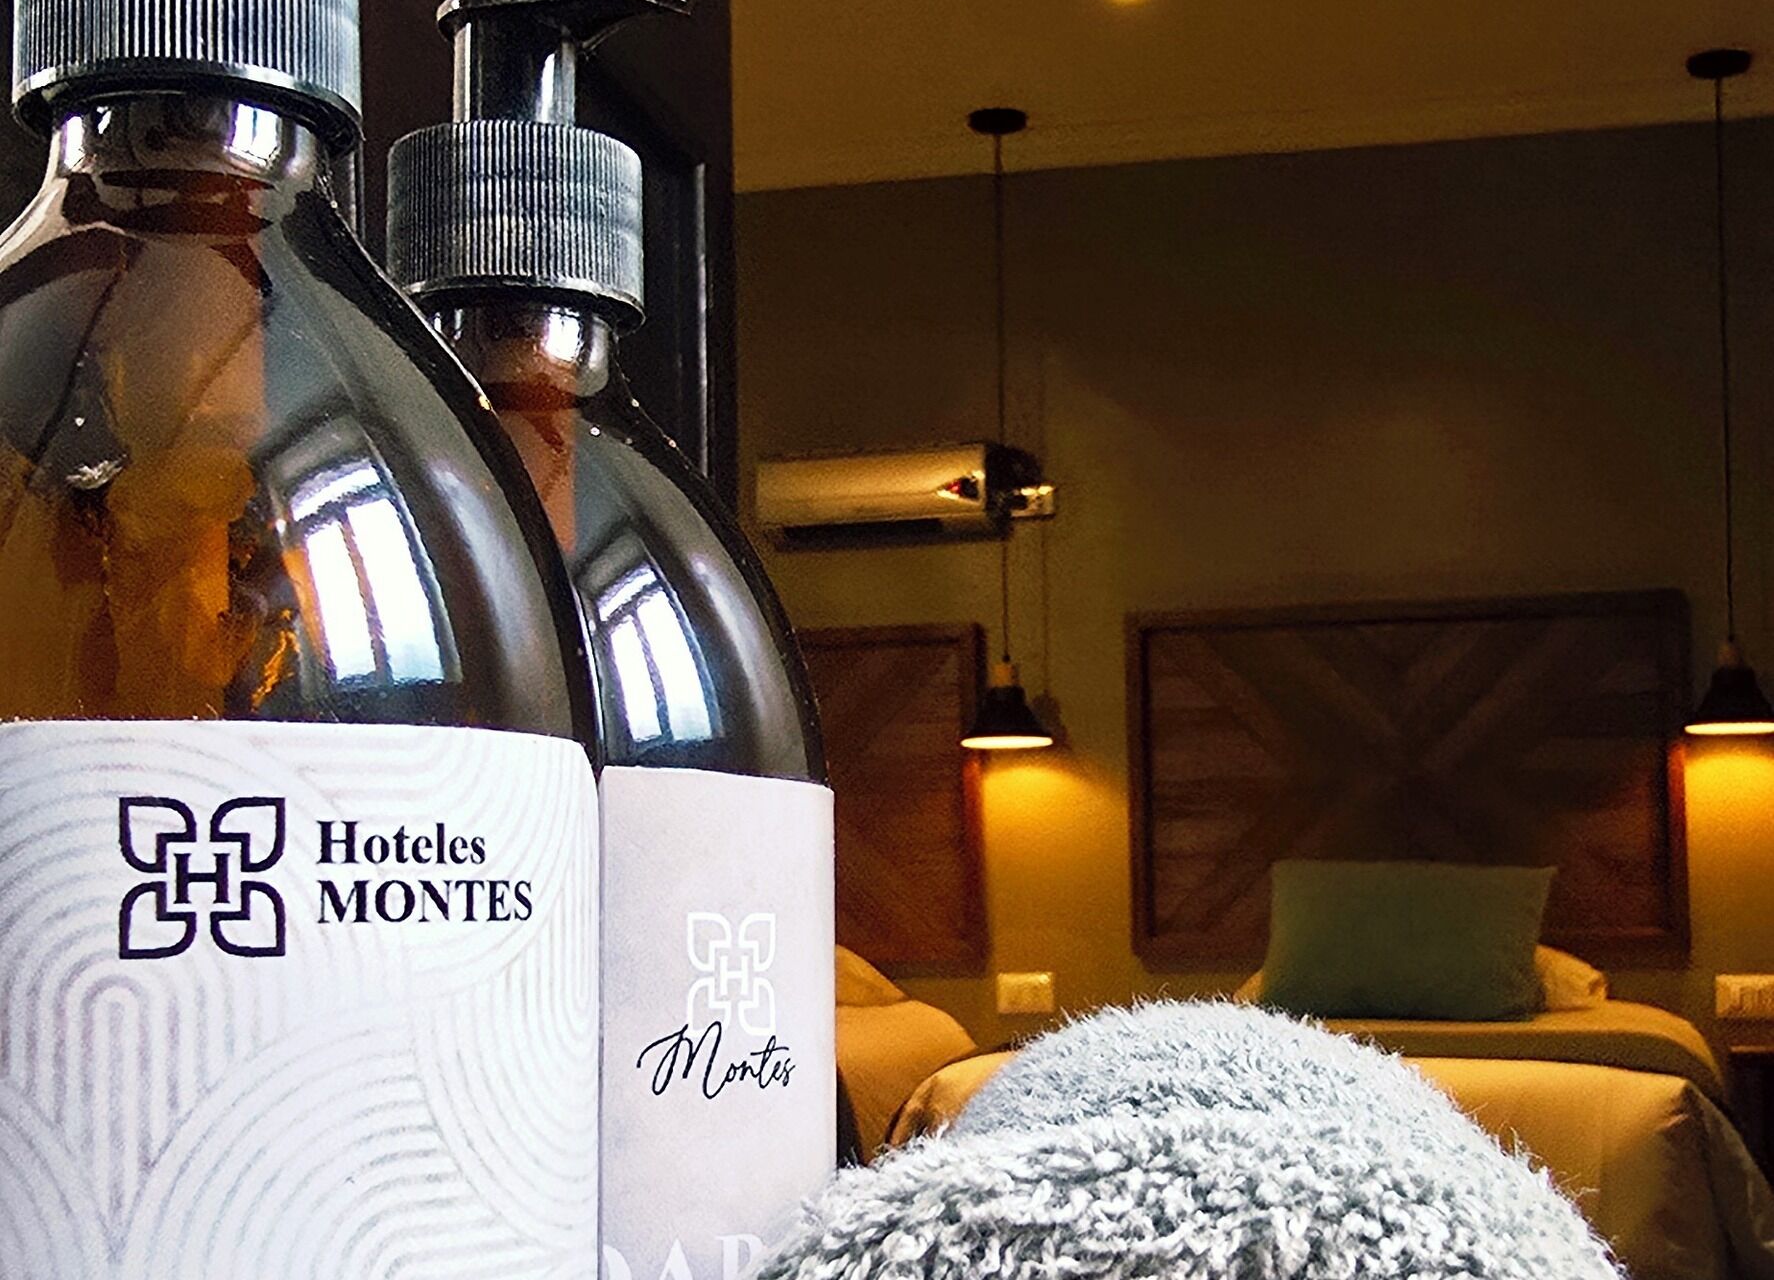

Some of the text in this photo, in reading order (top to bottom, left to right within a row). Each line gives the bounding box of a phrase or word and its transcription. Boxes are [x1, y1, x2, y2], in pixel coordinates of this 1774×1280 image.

[315, 820, 486, 865] Hoteles
[173, 853, 230, 905] H
[316, 879, 533, 923] MONTES
[636, 1020, 796, 1100] Montes
